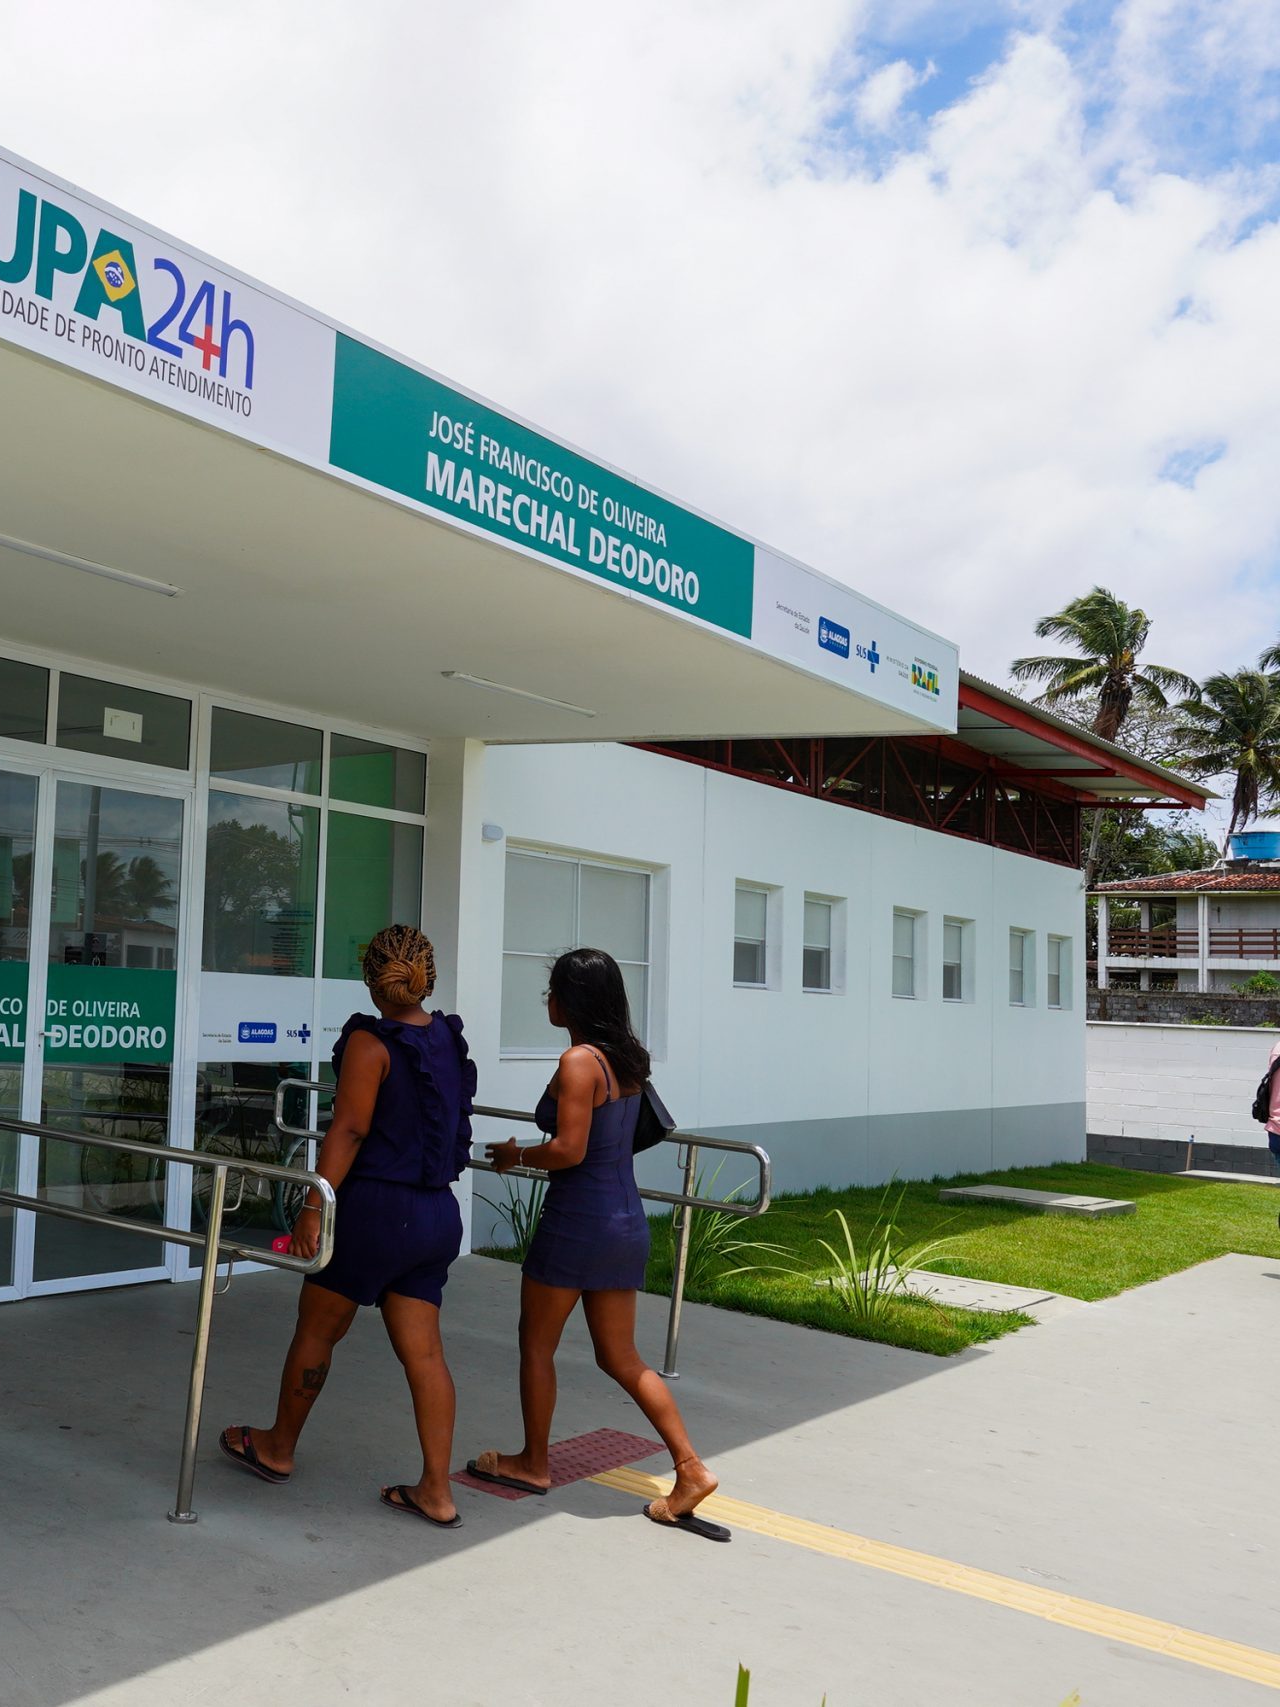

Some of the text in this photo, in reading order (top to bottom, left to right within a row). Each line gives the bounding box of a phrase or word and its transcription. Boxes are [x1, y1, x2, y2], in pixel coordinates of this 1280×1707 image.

[147, 257, 255, 391] 24h
[55, 312, 76, 348] DE
[82, 325, 145, 373] PRONTO
[149, 355, 252, 417] ATENDIMENTO
[429, 411, 667, 547] JOSÉ FRANCISCO DE OLIVEIRA
[426, 451, 700, 605] MARECHAL DEODORO
[856, 644, 867, 660] SUS
[47, 999, 67, 1017] DE
[72, 1000, 140, 1018] OLIVEIRA
[50, 1024, 167, 1049] DEODORO
[250, 1028, 274, 1036] ALAGOAS
[286, 1030, 298, 1038] SUS
